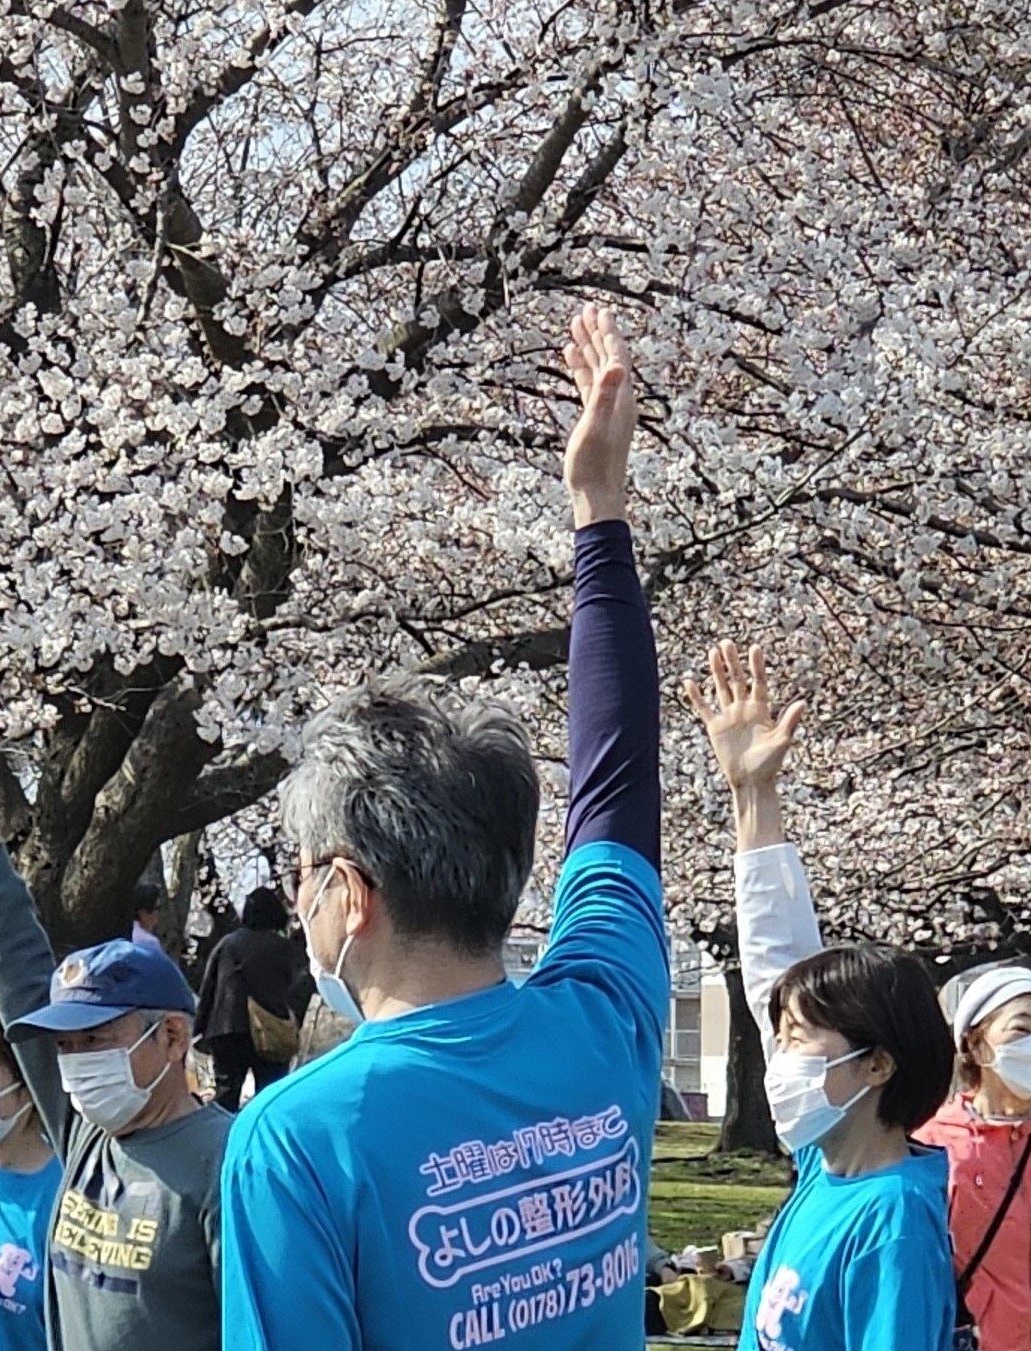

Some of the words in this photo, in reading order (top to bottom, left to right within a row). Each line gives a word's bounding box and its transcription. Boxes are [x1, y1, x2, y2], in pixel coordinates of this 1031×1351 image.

[420, 1104, 627, 1197] 土曜は17時まで
[125, 1218, 159, 1243] IS
[472, 1283, 500, 1306] Are
[500, 1273, 531, 1296] You
[531, 1258, 563, 1286] OK?
[450, 1302, 506, 1351] CALL
